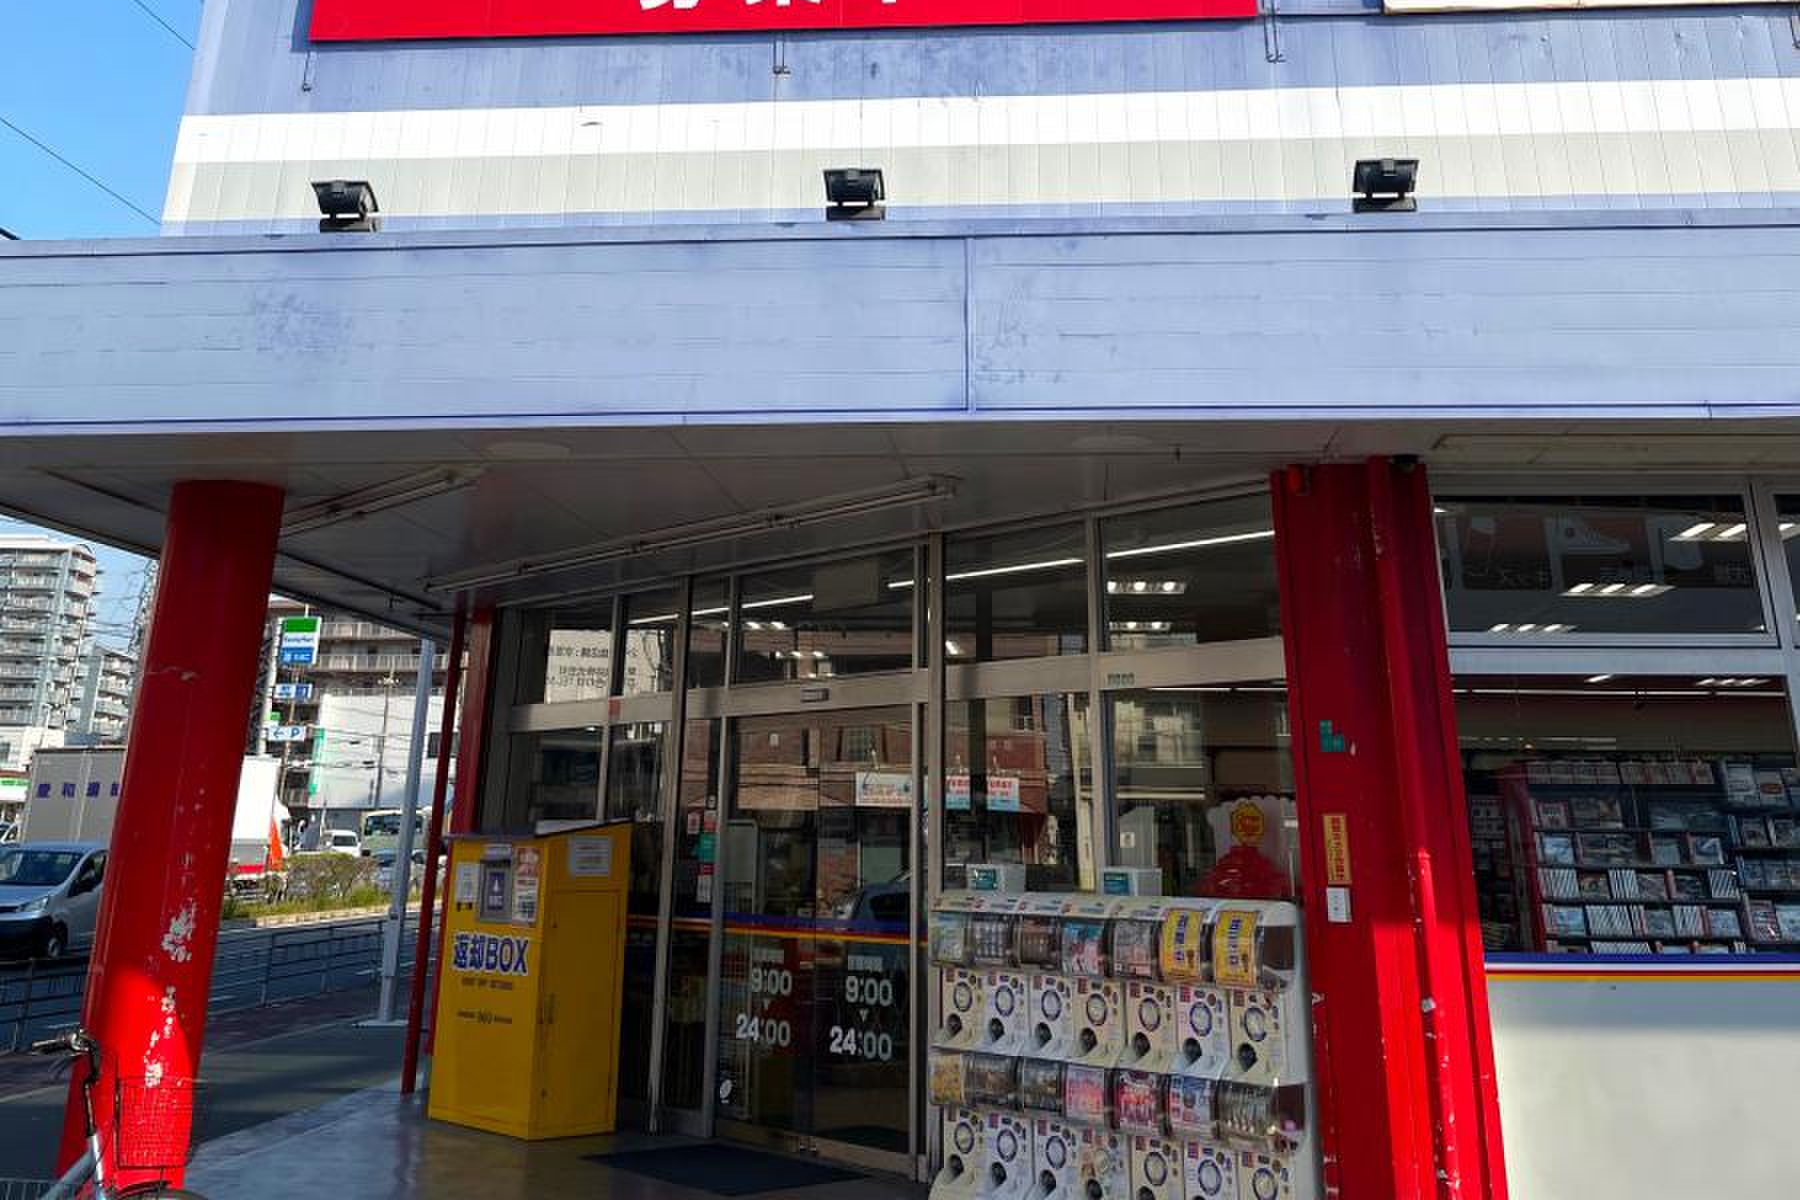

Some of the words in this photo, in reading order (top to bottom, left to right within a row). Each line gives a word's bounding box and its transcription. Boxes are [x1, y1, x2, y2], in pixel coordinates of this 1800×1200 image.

[751, 967, 793, 996] 9:00
[845, 975, 893, 1007] 9:00
[736, 1013, 791, 1048] 24:00
[830, 1025, 893, 1061] 24:00
